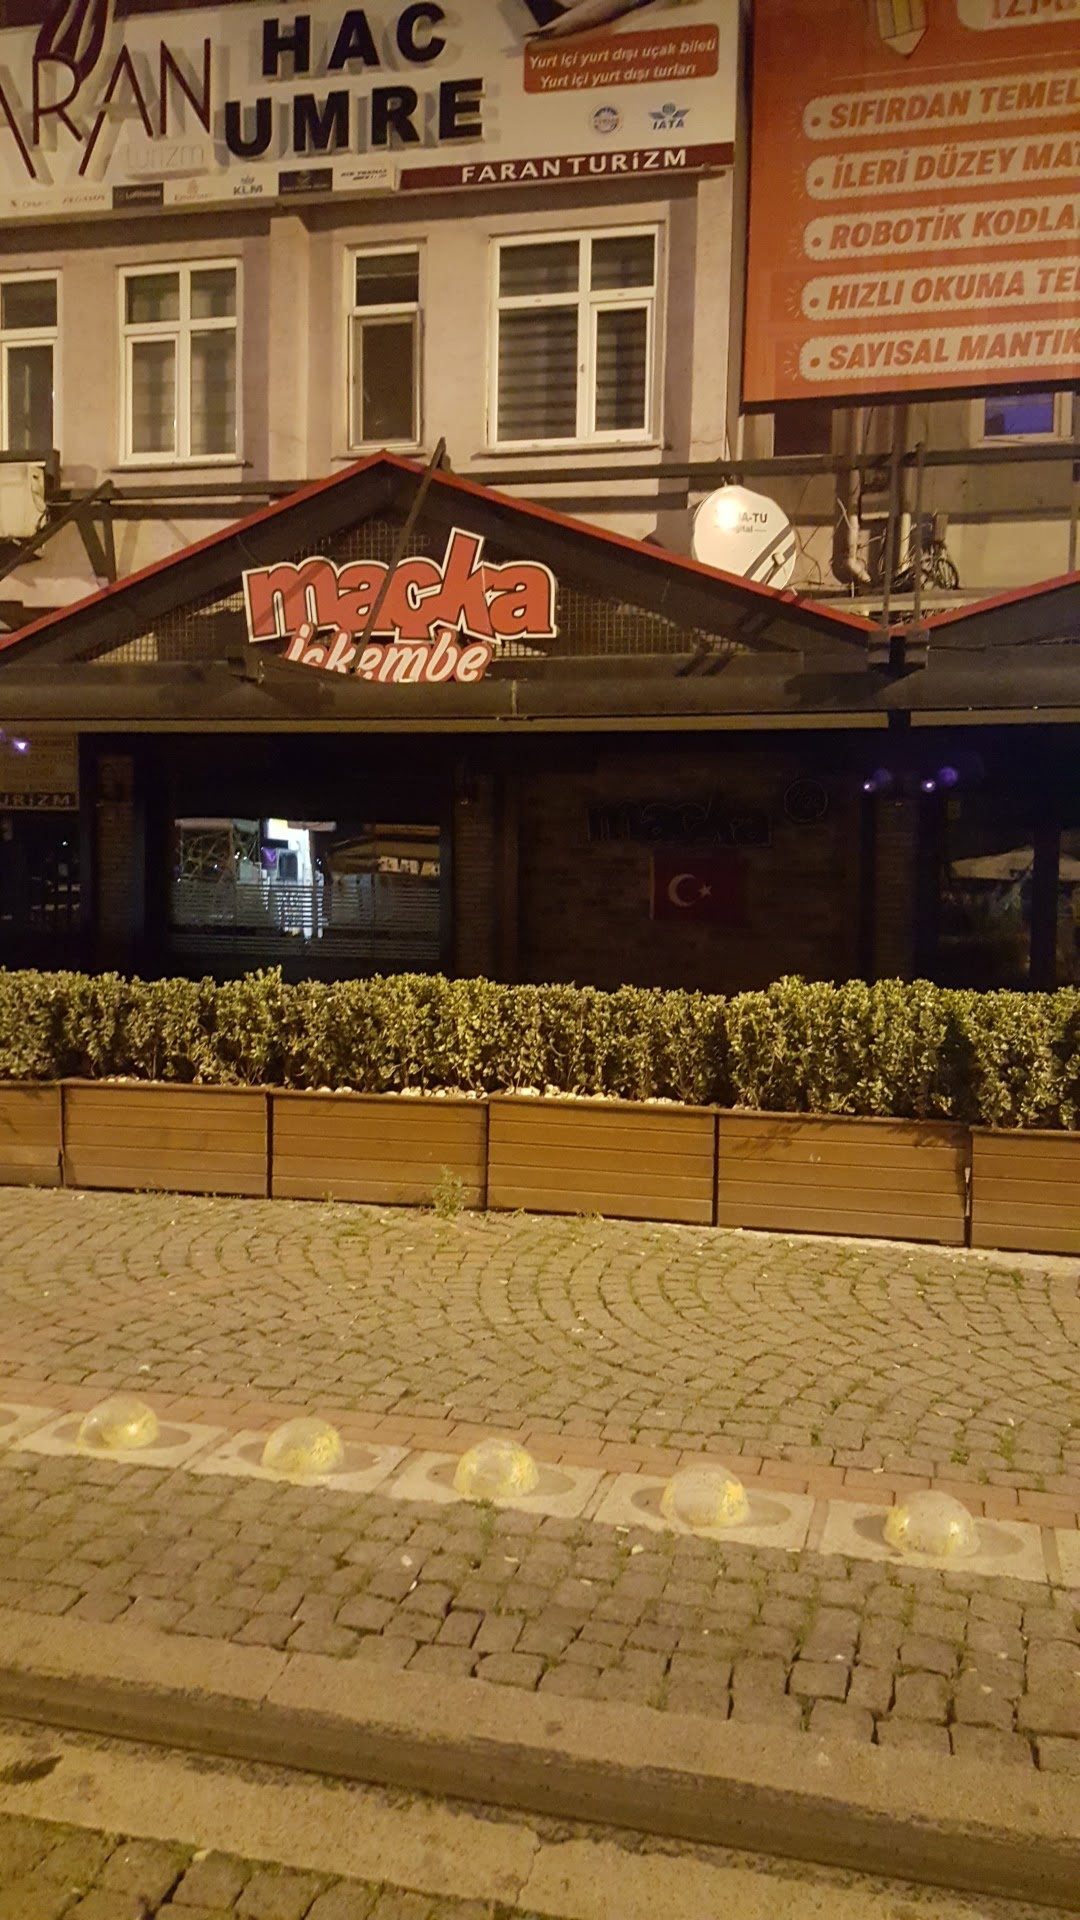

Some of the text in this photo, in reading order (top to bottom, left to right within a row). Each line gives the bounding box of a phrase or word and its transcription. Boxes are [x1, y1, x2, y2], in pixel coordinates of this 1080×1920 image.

[262, 2, 446, 76] HAC
[530, 52, 557, 69] Yurt
[581, 49, 608, 67] yurt
[643, 44, 675, 60] uçak
[679, 38, 716, 54] bileti
[540, 73, 568, 89] Yurt
[591, 69, 619, 87] yurt
[225, 78, 483, 157] UMRE
[652, 117, 685, 131] IATA
[828, 89, 971, 130] SIFIRDAN
[462, 148, 687, 183] FARAN TURİZM
[832, 150, 908, 190] İLERİ
[913, 144, 1017, 182] DÜZEY
[233, 184, 263, 196] KLM
[828, 204, 1080, 251] ROBOTİK KODLA
[826, 278, 904, 311] HIZLI
[911, 269, 1024, 304] OKUMA
[828, 338, 950, 371] SAYISAL
[243, 527, 557, 642] maçka
